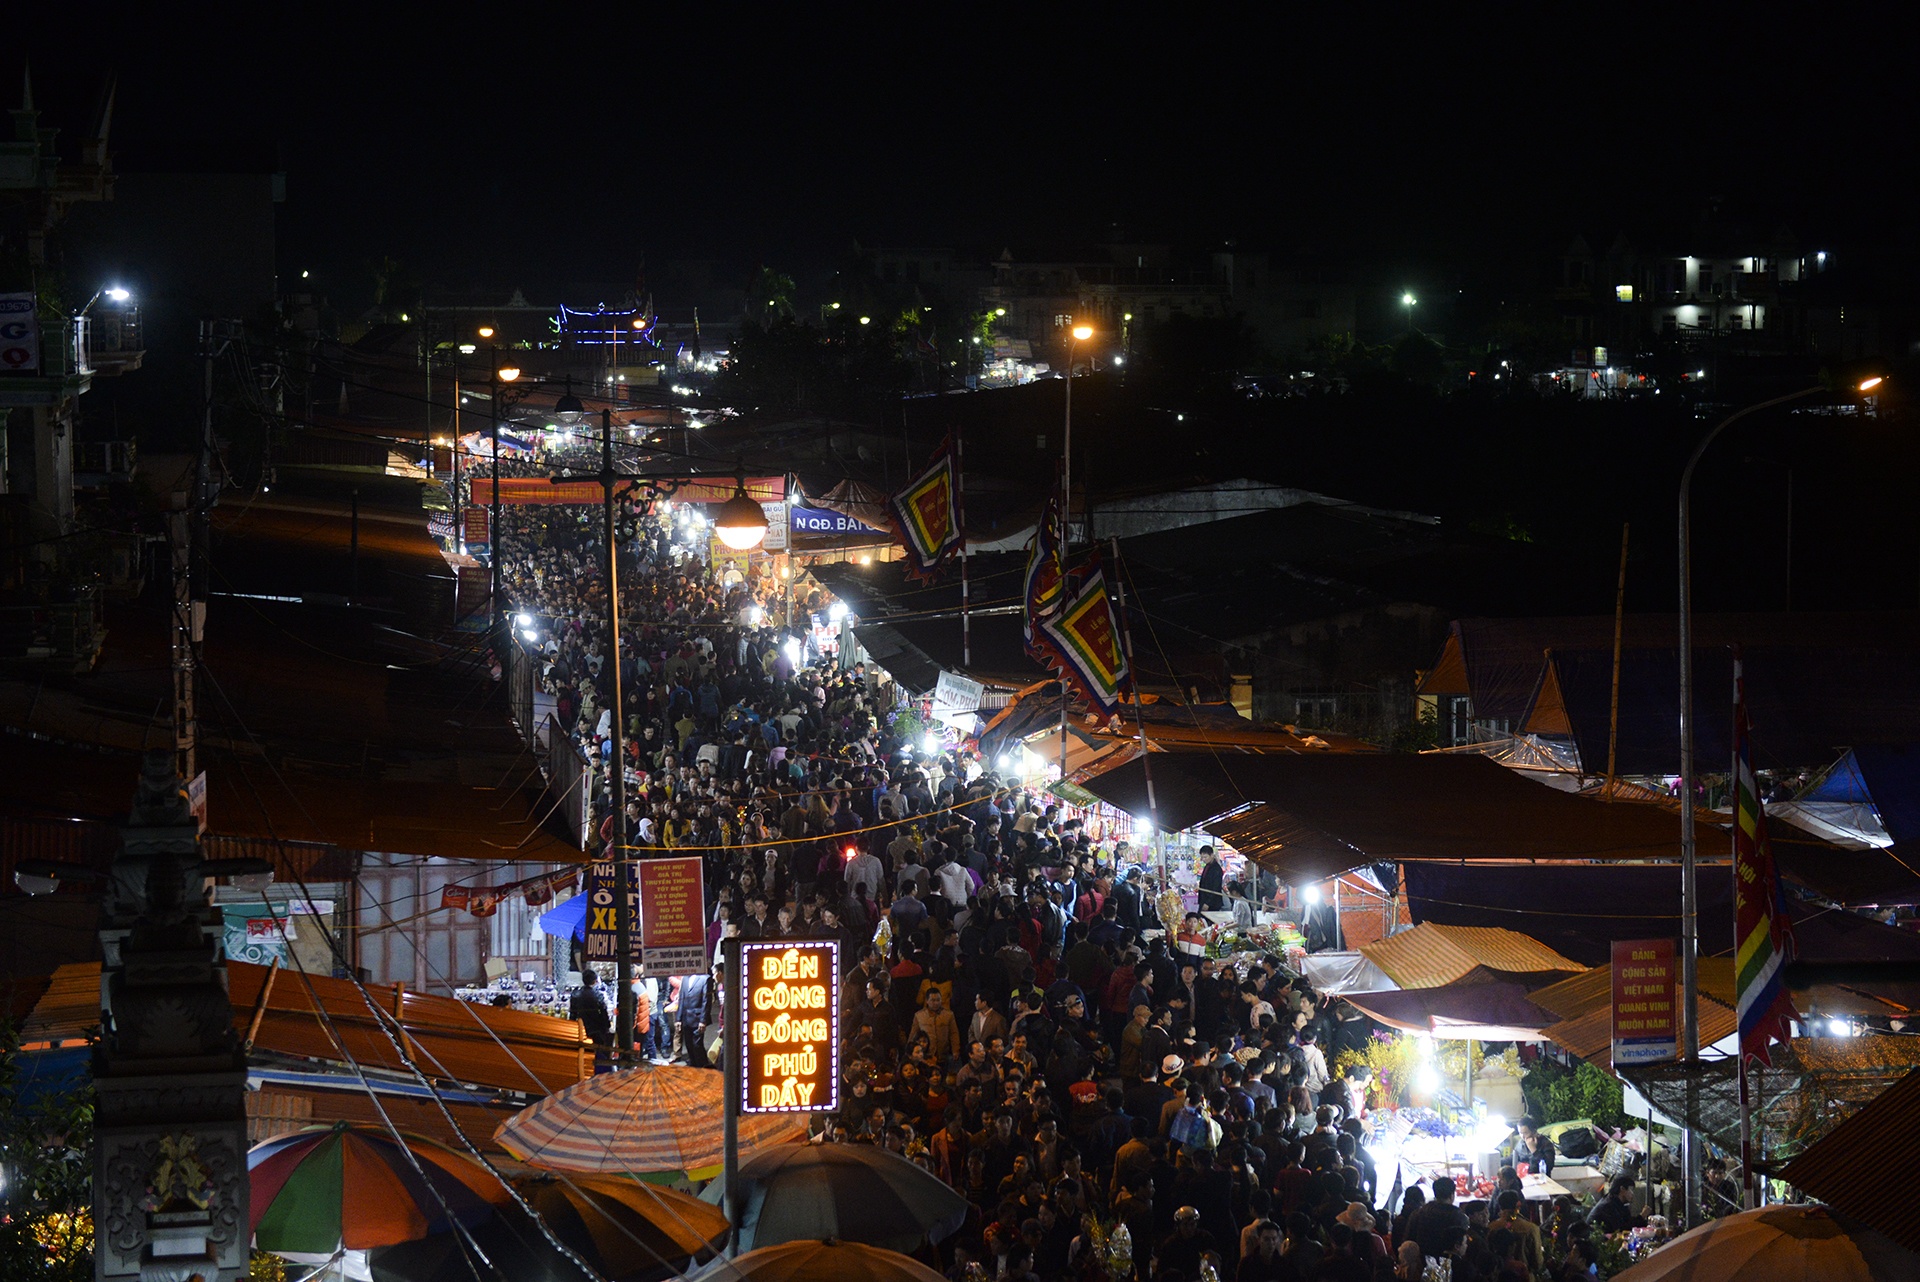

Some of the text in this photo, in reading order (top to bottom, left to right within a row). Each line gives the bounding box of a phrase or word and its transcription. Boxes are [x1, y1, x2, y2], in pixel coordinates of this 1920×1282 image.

[1738, 861, 1757, 884] HỘI
[587, 934, 609, 958] DỊCH
[1622, 966, 1646, 980] CỘNG
[754, 982, 826, 1010] CÔNG
[1623, 984, 1665, 997] VIỆT NAM
[1618, 1001, 1670, 1014] QUANG VINH
[752, 1013, 827, 1044] ĐỒNG
[1618, 1018, 1644, 1030] MUÔN
[764, 1045, 817, 1076] PHỦ
[1622, 1048, 1668, 1058] vinaphone
